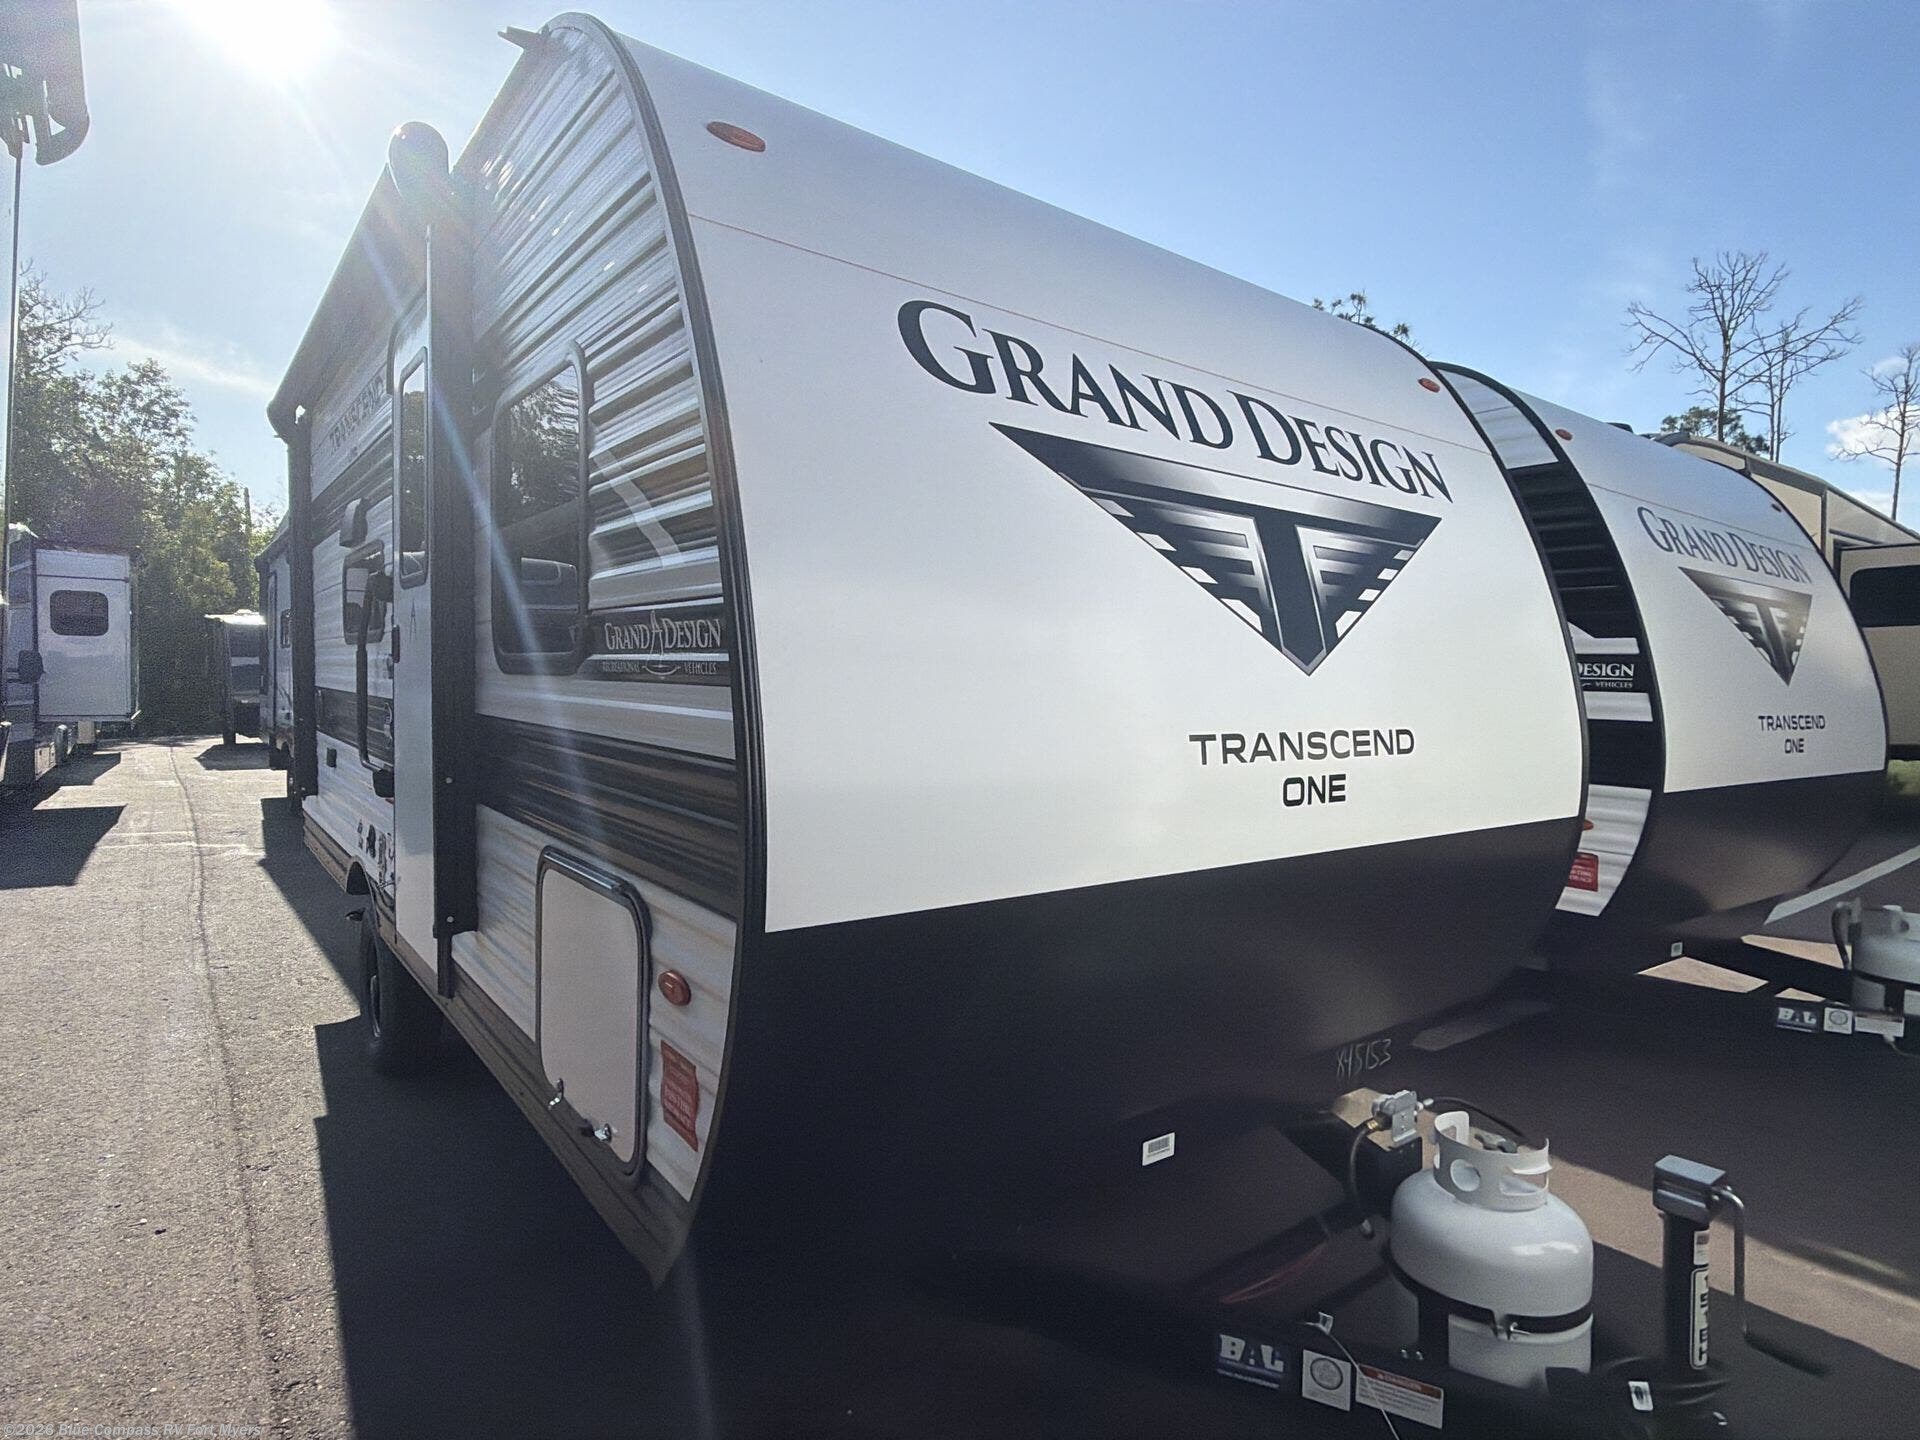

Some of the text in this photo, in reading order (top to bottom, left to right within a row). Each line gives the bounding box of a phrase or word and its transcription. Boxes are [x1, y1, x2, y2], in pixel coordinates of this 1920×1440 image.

[897, 299, 1453, 503] GRAND DESIGN
[1637, 505, 1812, 585] GRAND DESIGN
[604, 617, 721, 650] GRAND DESIGN
[684, 661, 717, 675] VEHICLES
[1595, 681, 1633, 689] VEHICLES
[1758, 715, 1826, 730] TRANSCEND
[1188, 729, 1415, 765] TRANSCEND
[1784, 738, 1804, 754] ONE
[1282, 773, 1347, 807] ONE
